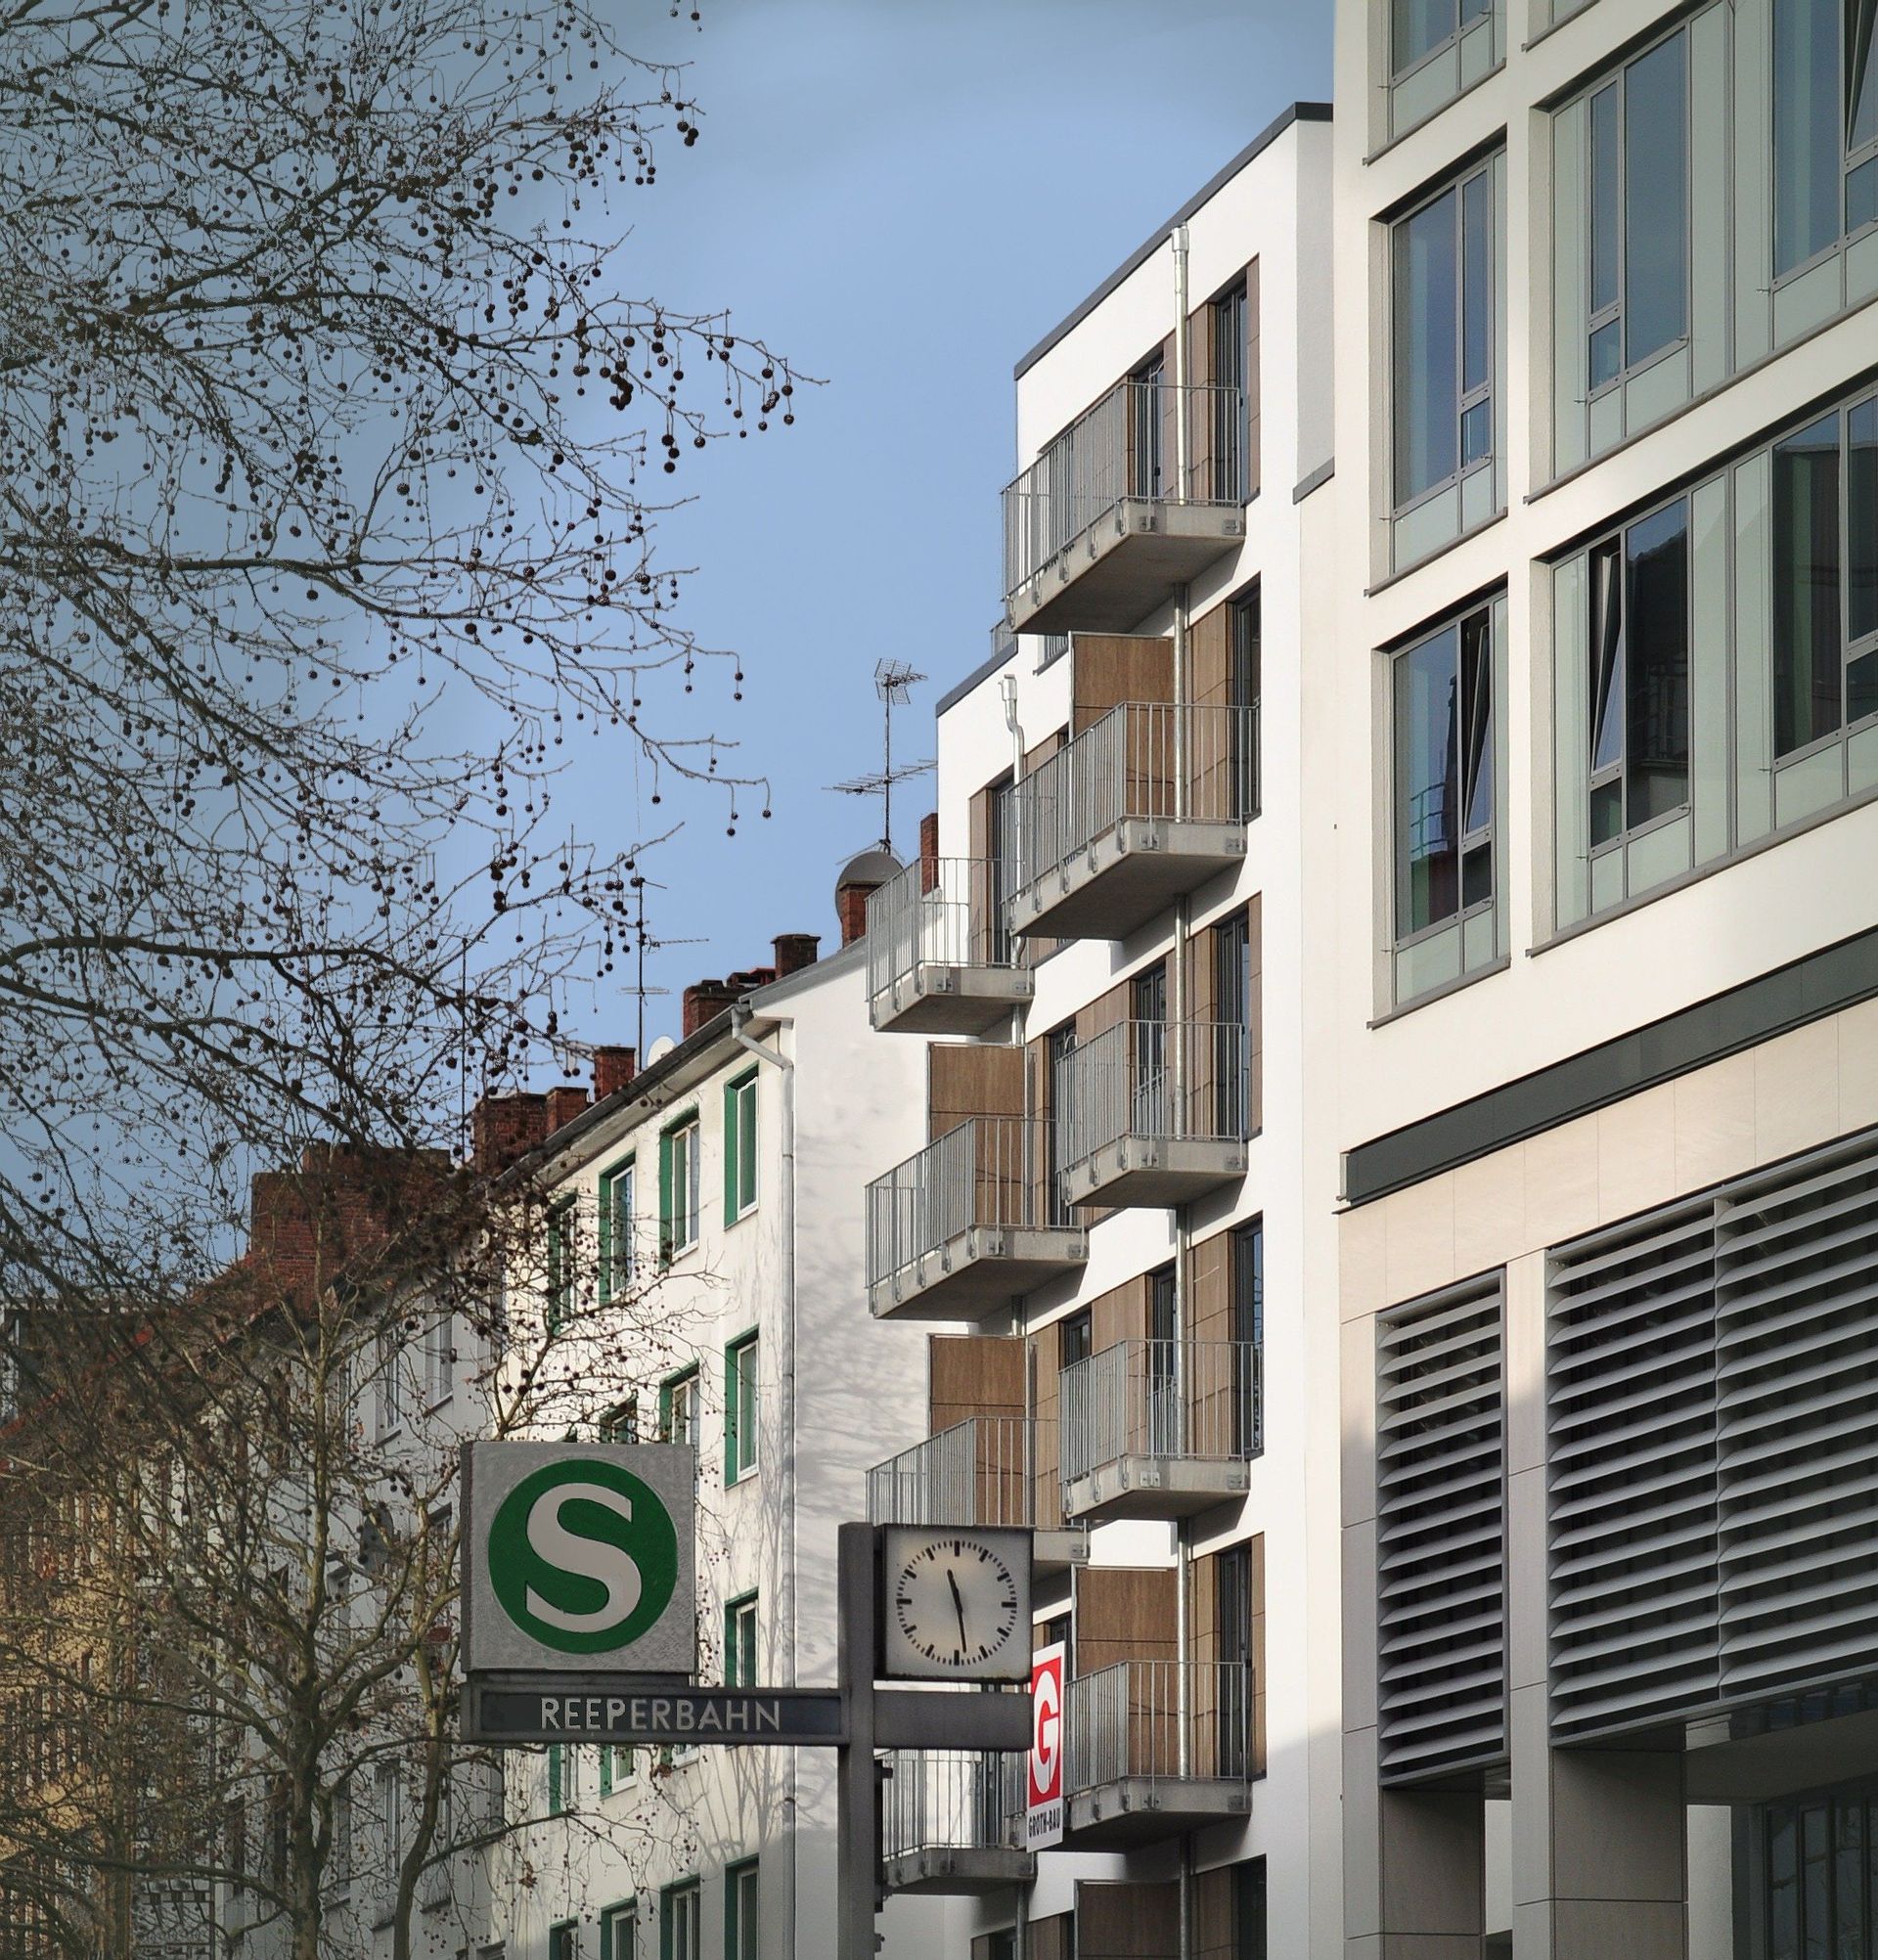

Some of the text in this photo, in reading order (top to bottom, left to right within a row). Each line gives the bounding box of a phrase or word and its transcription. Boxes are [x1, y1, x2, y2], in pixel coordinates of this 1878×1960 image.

[526, 1482, 643, 1633] S
[540, 1698, 781, 1731] REEPERBAHN
[1032, 1670, 1059, 1795] G
[1029, 1807, 1061, 1838] GROTH-BAU
